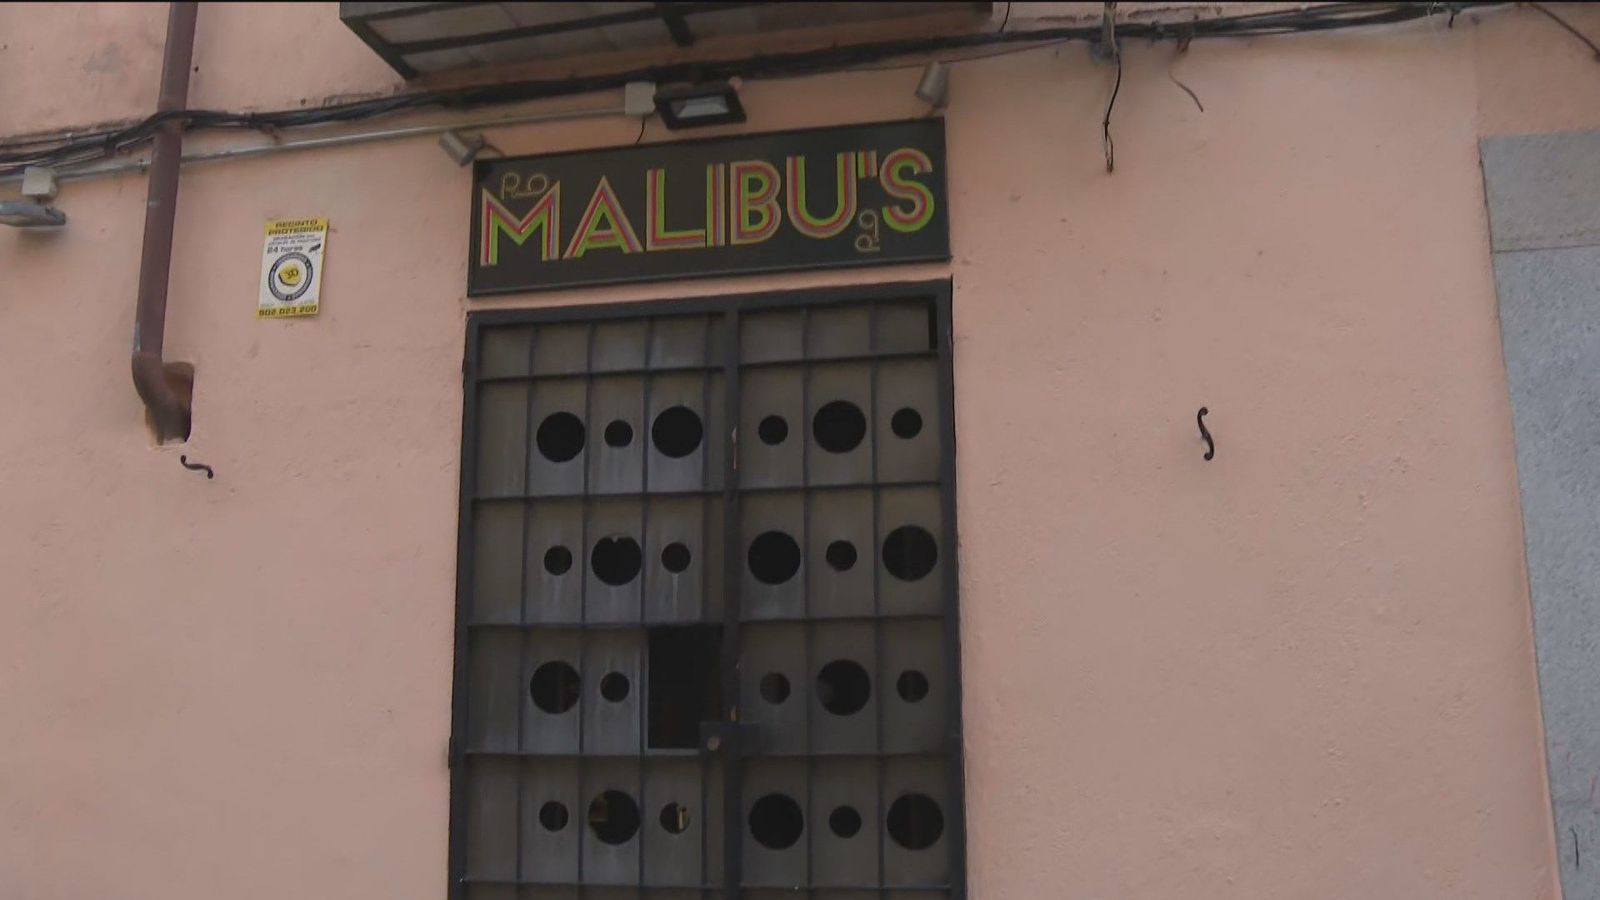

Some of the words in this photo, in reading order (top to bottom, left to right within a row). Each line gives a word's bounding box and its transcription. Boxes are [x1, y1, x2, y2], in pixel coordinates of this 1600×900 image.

[480, 147, 935, 267] MALIBU'S
[275, 219, 318, 229] RECINTO
[268, 225, 324, 236] PROTEGIDO
[267, 247, 279, 255] 24
[258, 308, 276, 316] 902
[279, 306, 297, 315] 023
[299, 304, 317, 313] 200
